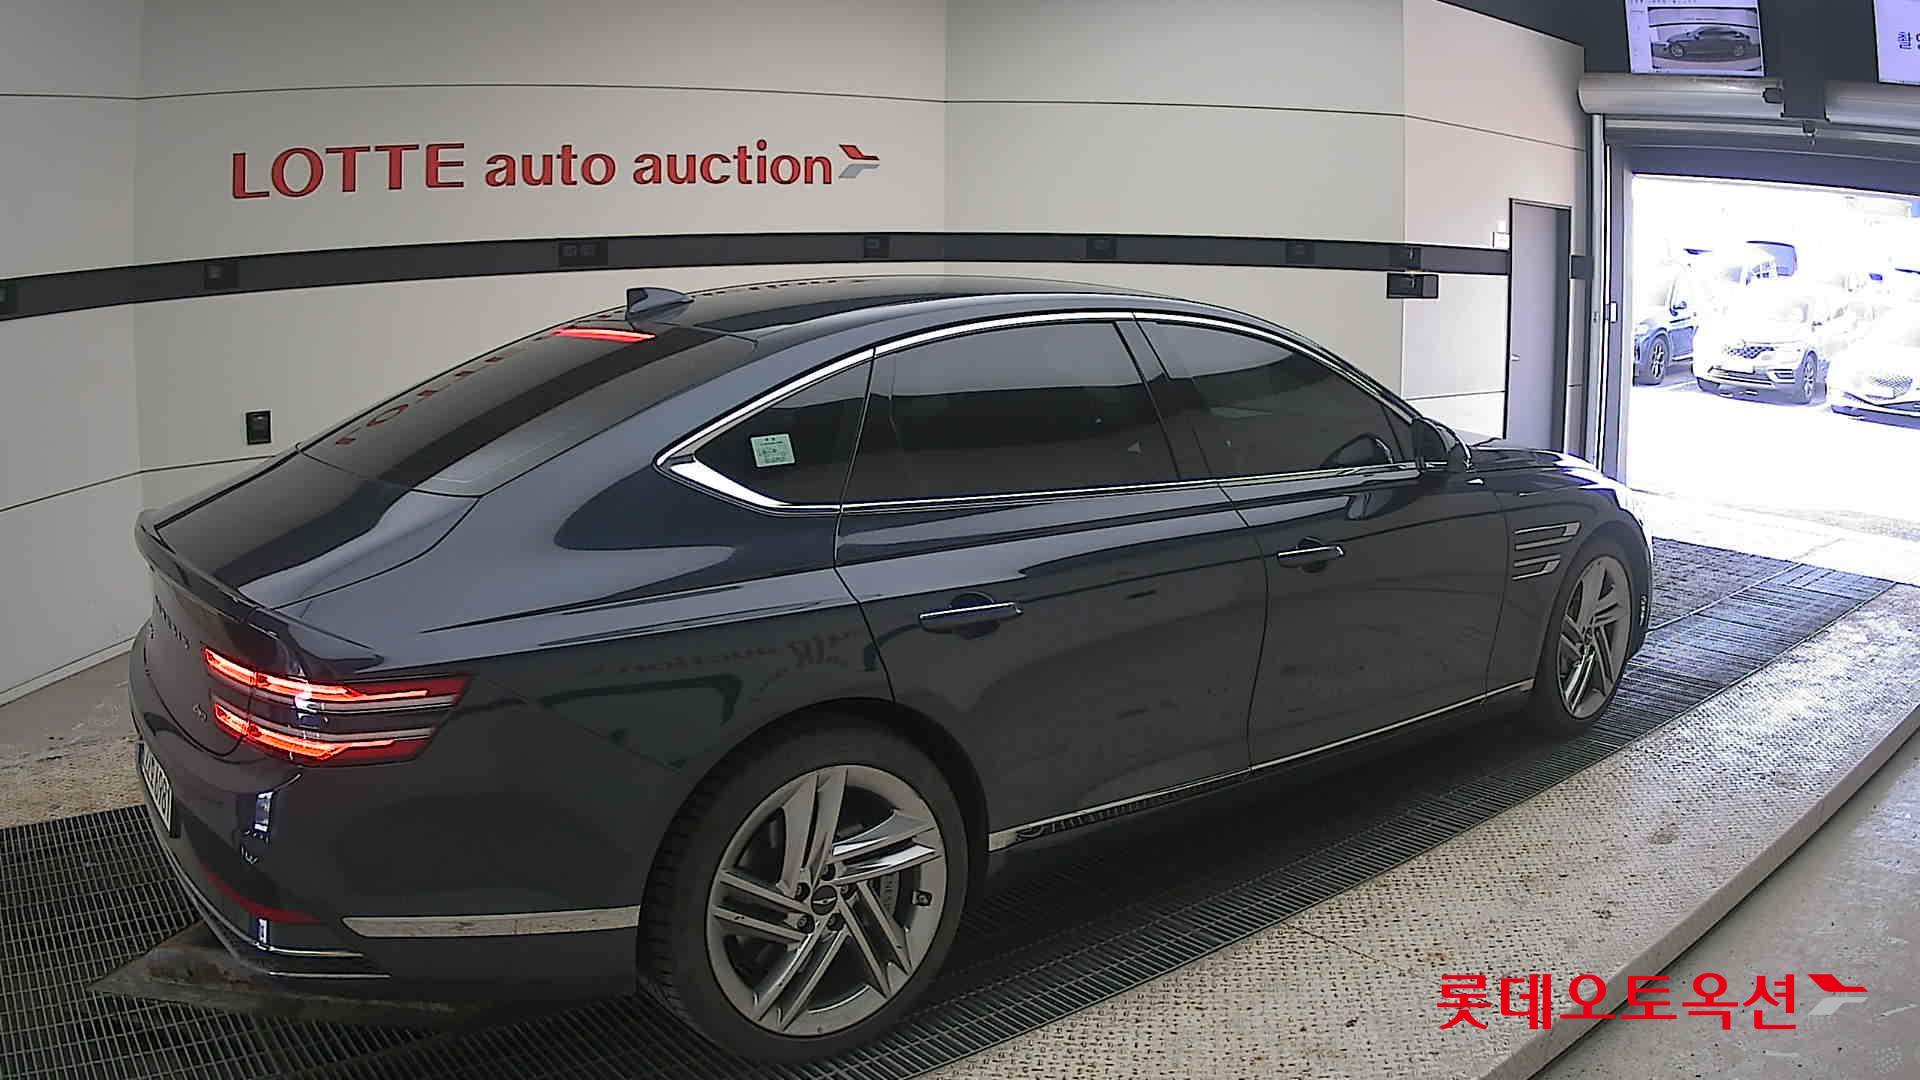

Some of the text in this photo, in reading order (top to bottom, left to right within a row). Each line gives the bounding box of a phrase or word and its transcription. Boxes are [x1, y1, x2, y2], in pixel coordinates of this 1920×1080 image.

[232, 139, 832, 199] LOTTE auto auction
